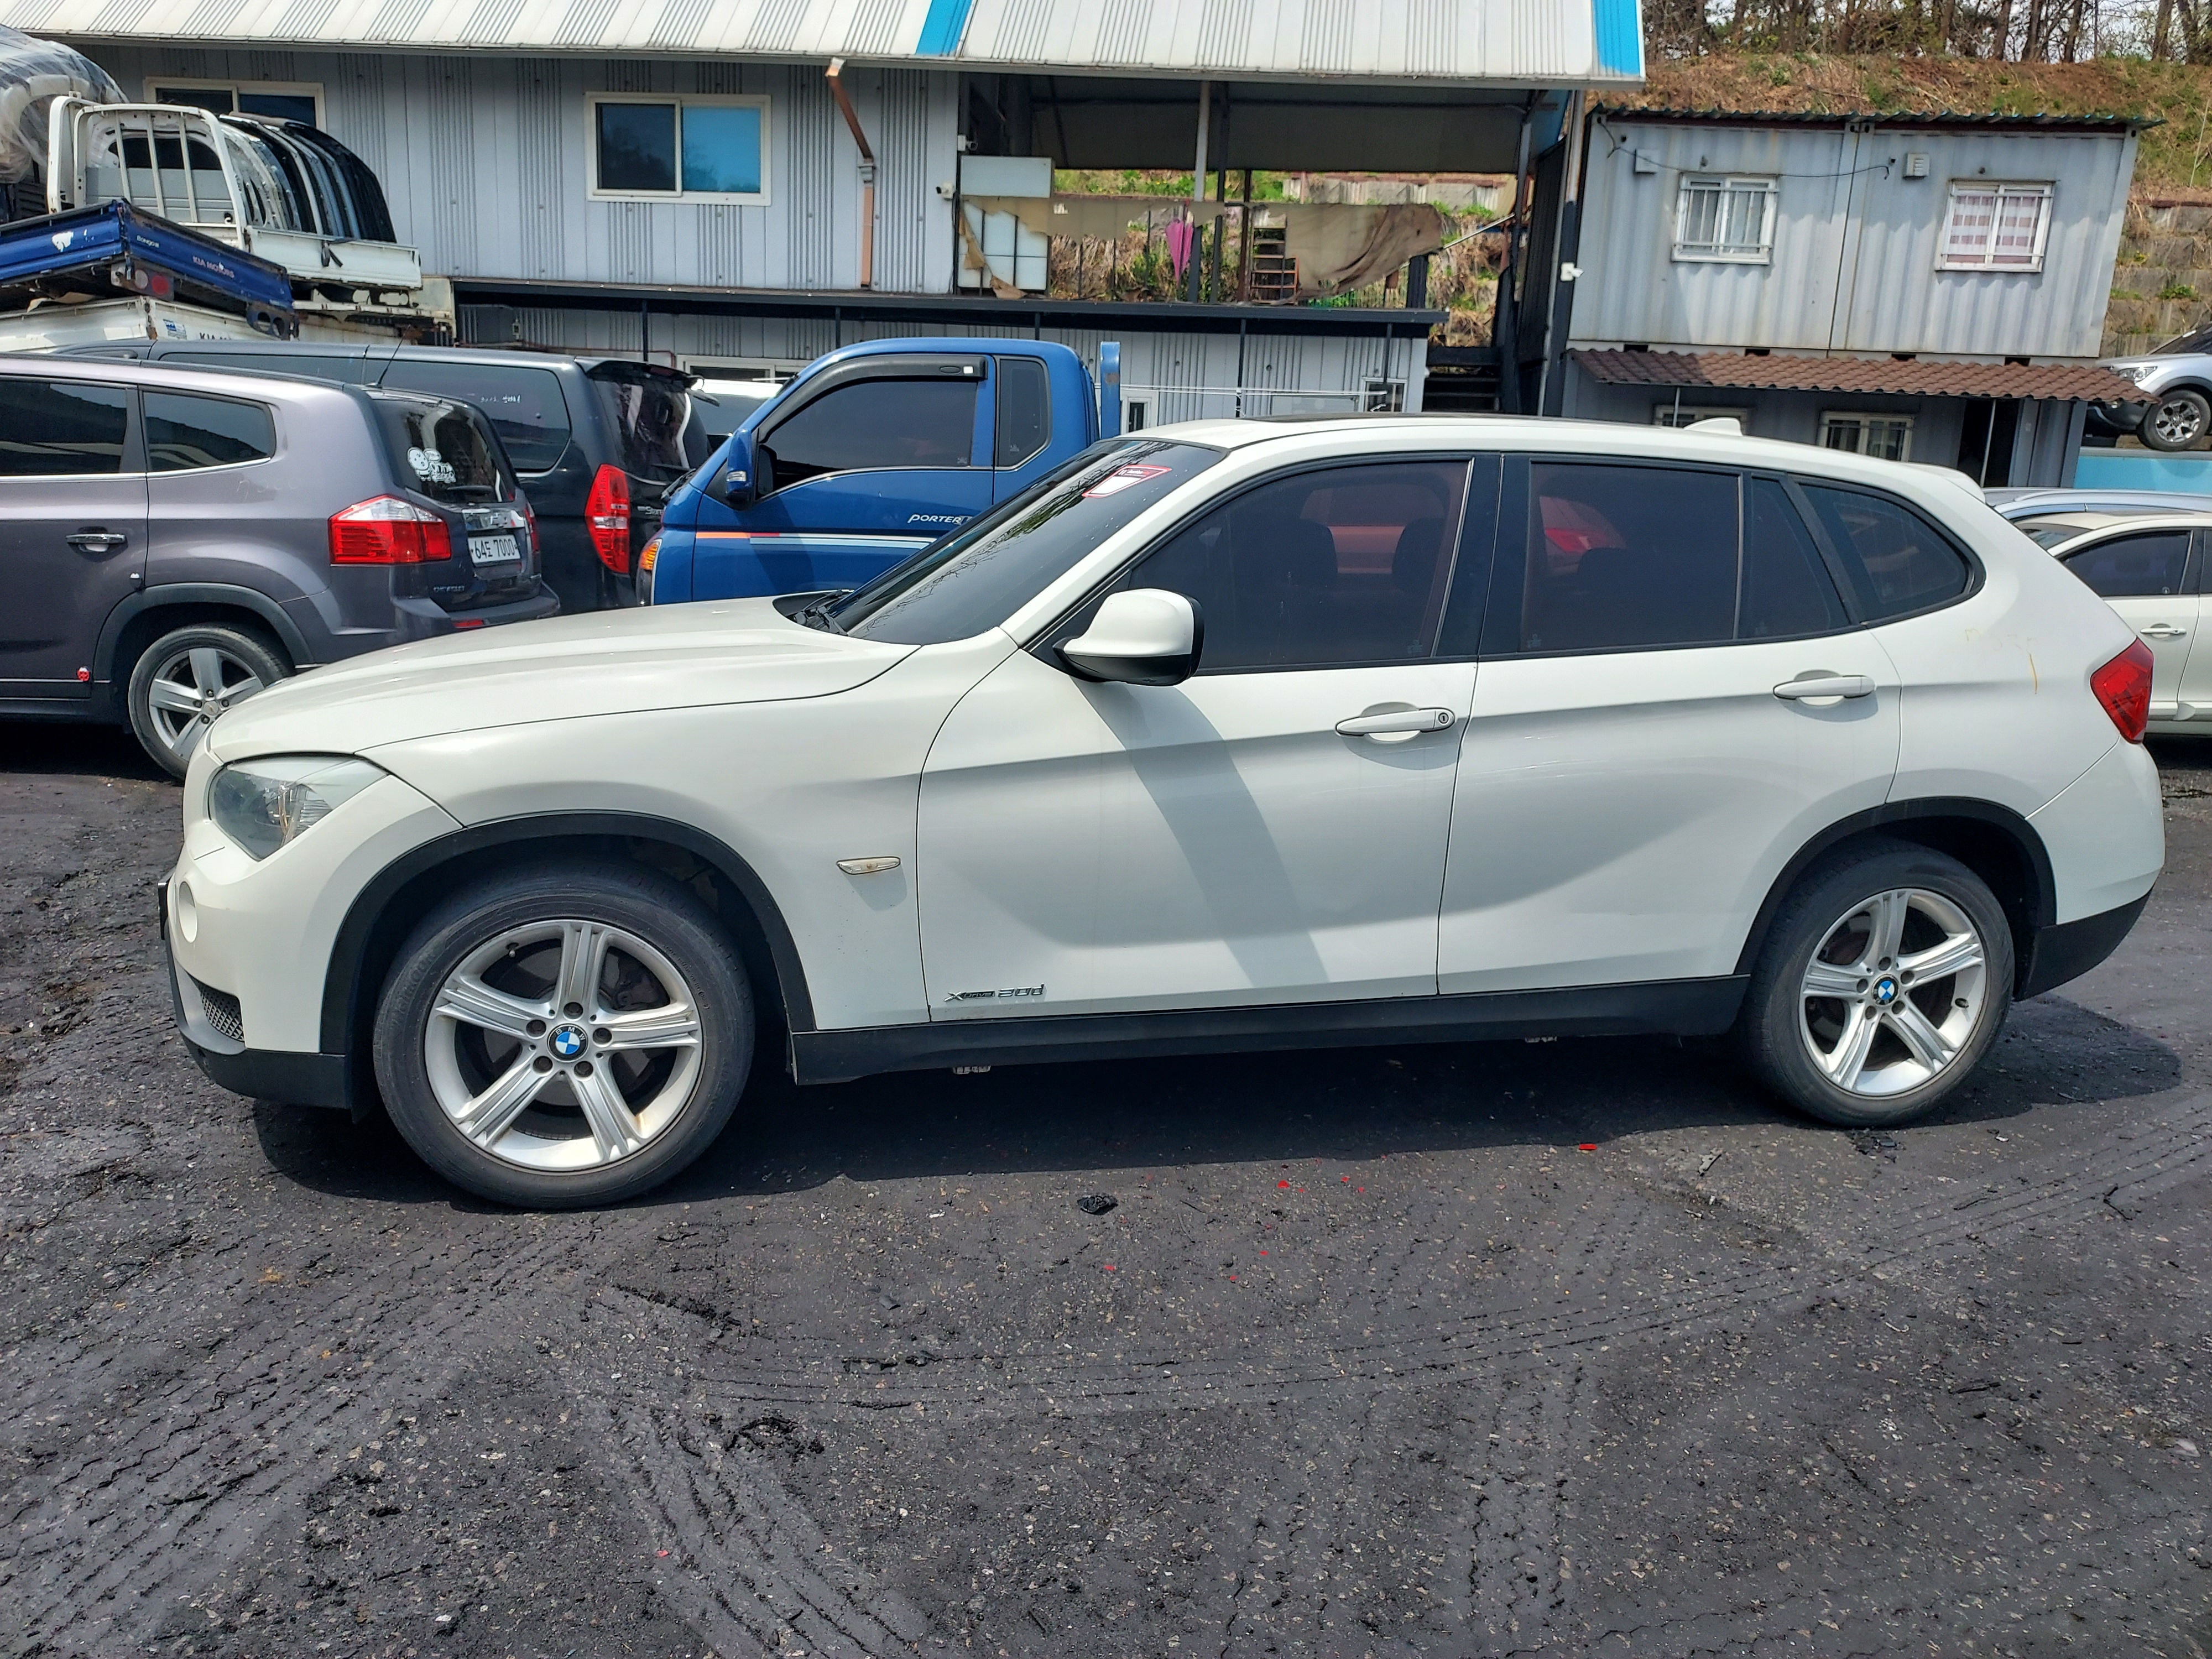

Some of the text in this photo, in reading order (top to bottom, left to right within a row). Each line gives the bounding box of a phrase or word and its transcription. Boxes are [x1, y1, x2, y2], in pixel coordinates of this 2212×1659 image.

[907, 514, 962, 524] PORTER
[474, 538, 515, 560] 64도 7000
[555, 1026, 586, 1041] BMW
